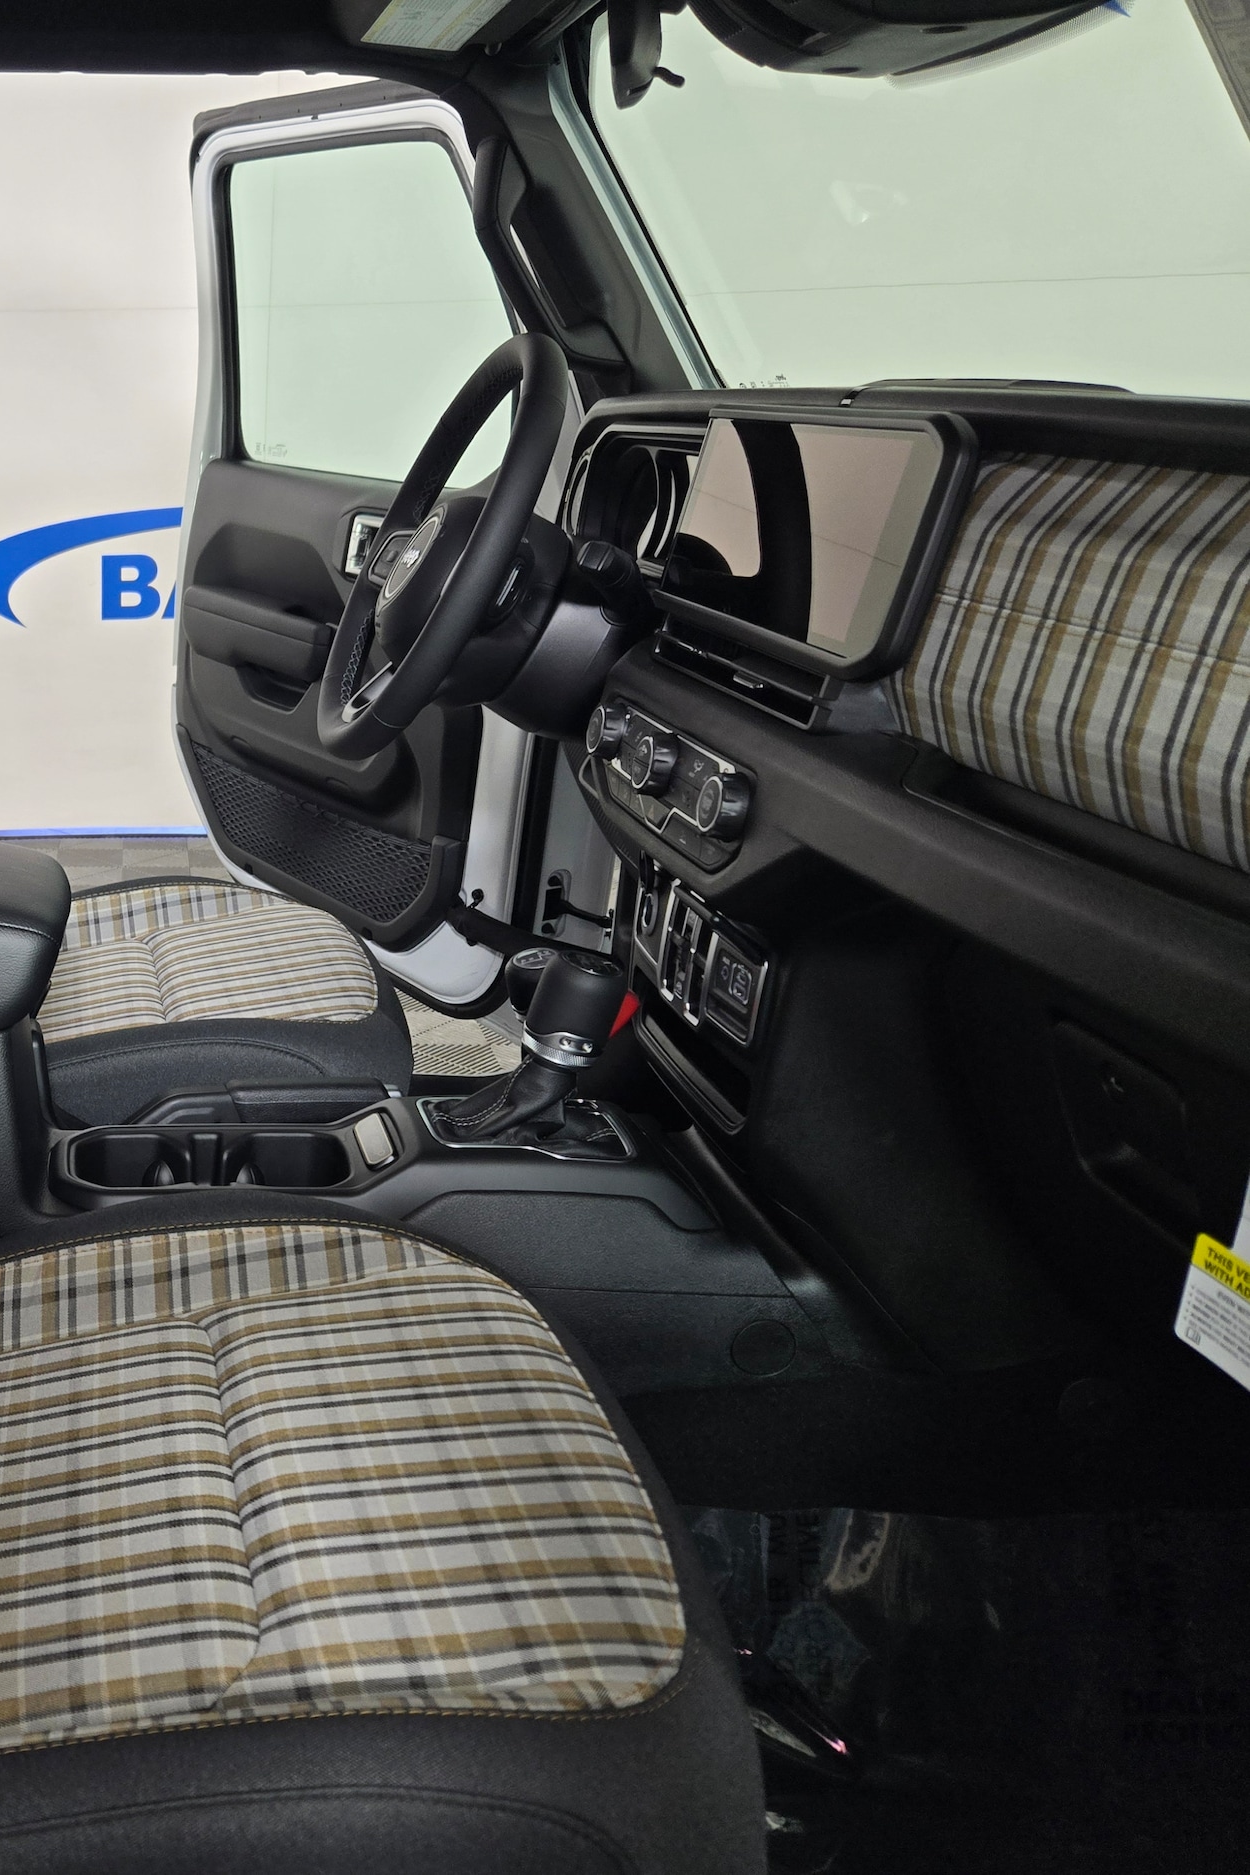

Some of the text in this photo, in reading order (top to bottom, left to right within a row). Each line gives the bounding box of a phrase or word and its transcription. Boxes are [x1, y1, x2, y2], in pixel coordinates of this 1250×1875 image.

[101, 554, 176, 621] B
[1204, 1259, 1234, 1286] WITH
[1207, 1246, 1233, 1272] THIS
